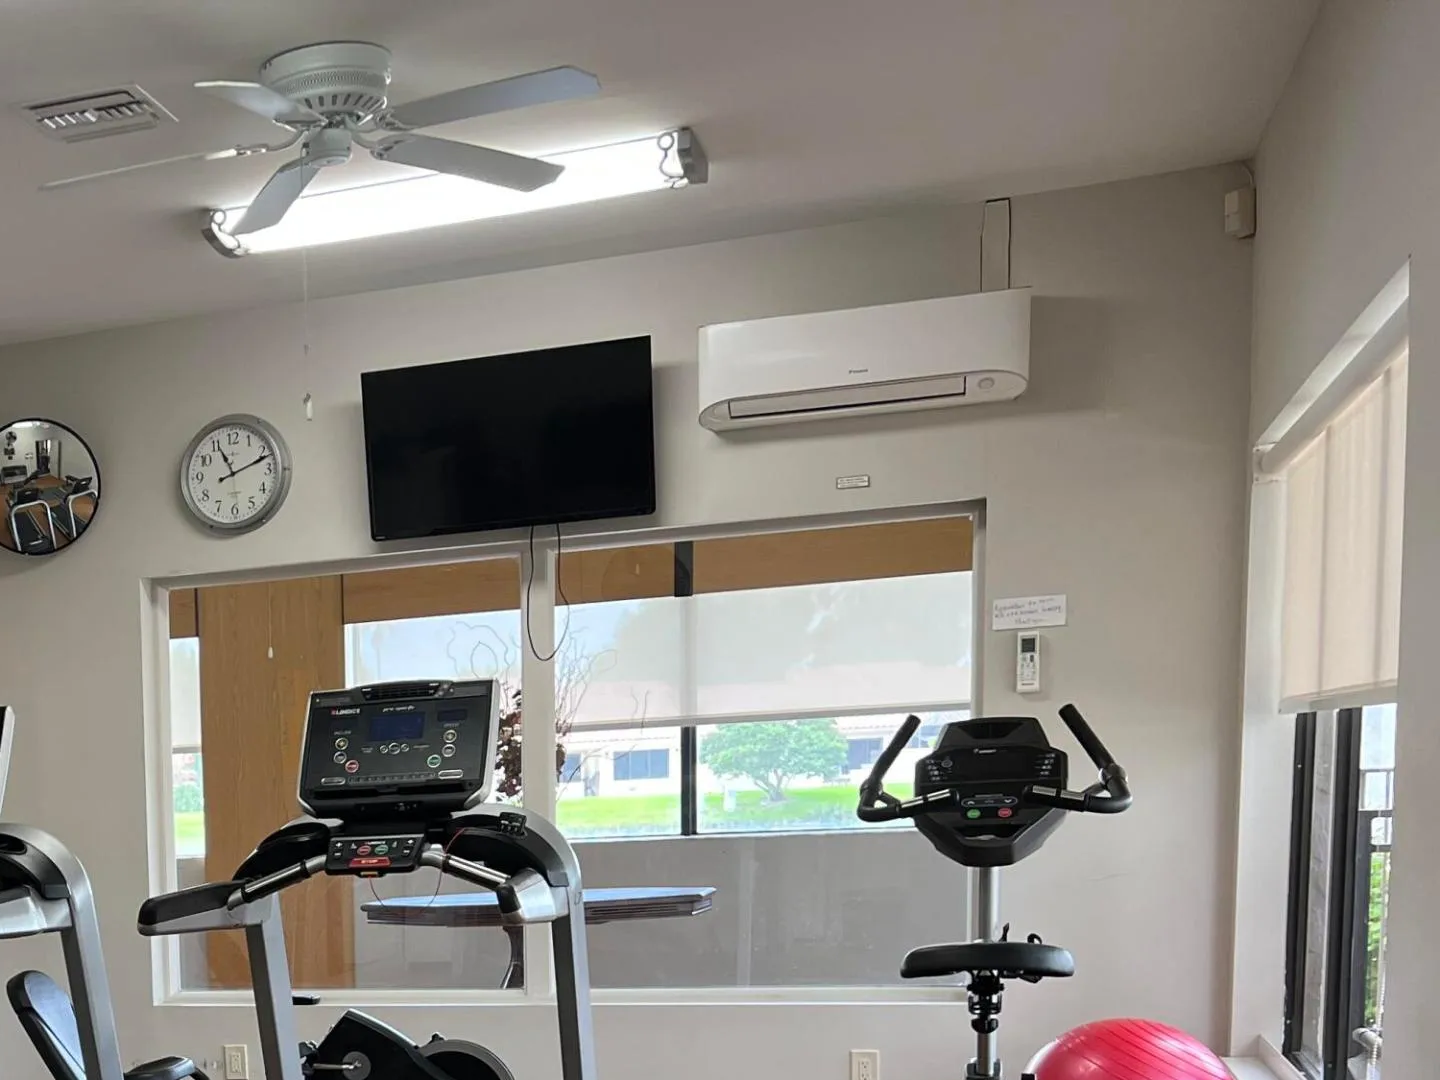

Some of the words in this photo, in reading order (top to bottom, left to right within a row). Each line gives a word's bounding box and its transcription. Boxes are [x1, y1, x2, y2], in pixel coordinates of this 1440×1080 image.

[227, 432, 239, 445] 12
[212, 440, 220, 452] 11
[200, 454, 212, 467] 10
[264, 463, 272, 476] 3
[196, 471, 205, 484] 9
[259, 481, 266, 494] 4
[201, 489, 210, 502] 8
[215, 500, 222, 513] 7
[230, 503, 239, 516] 6
[247, 496, 255, 510] 5
